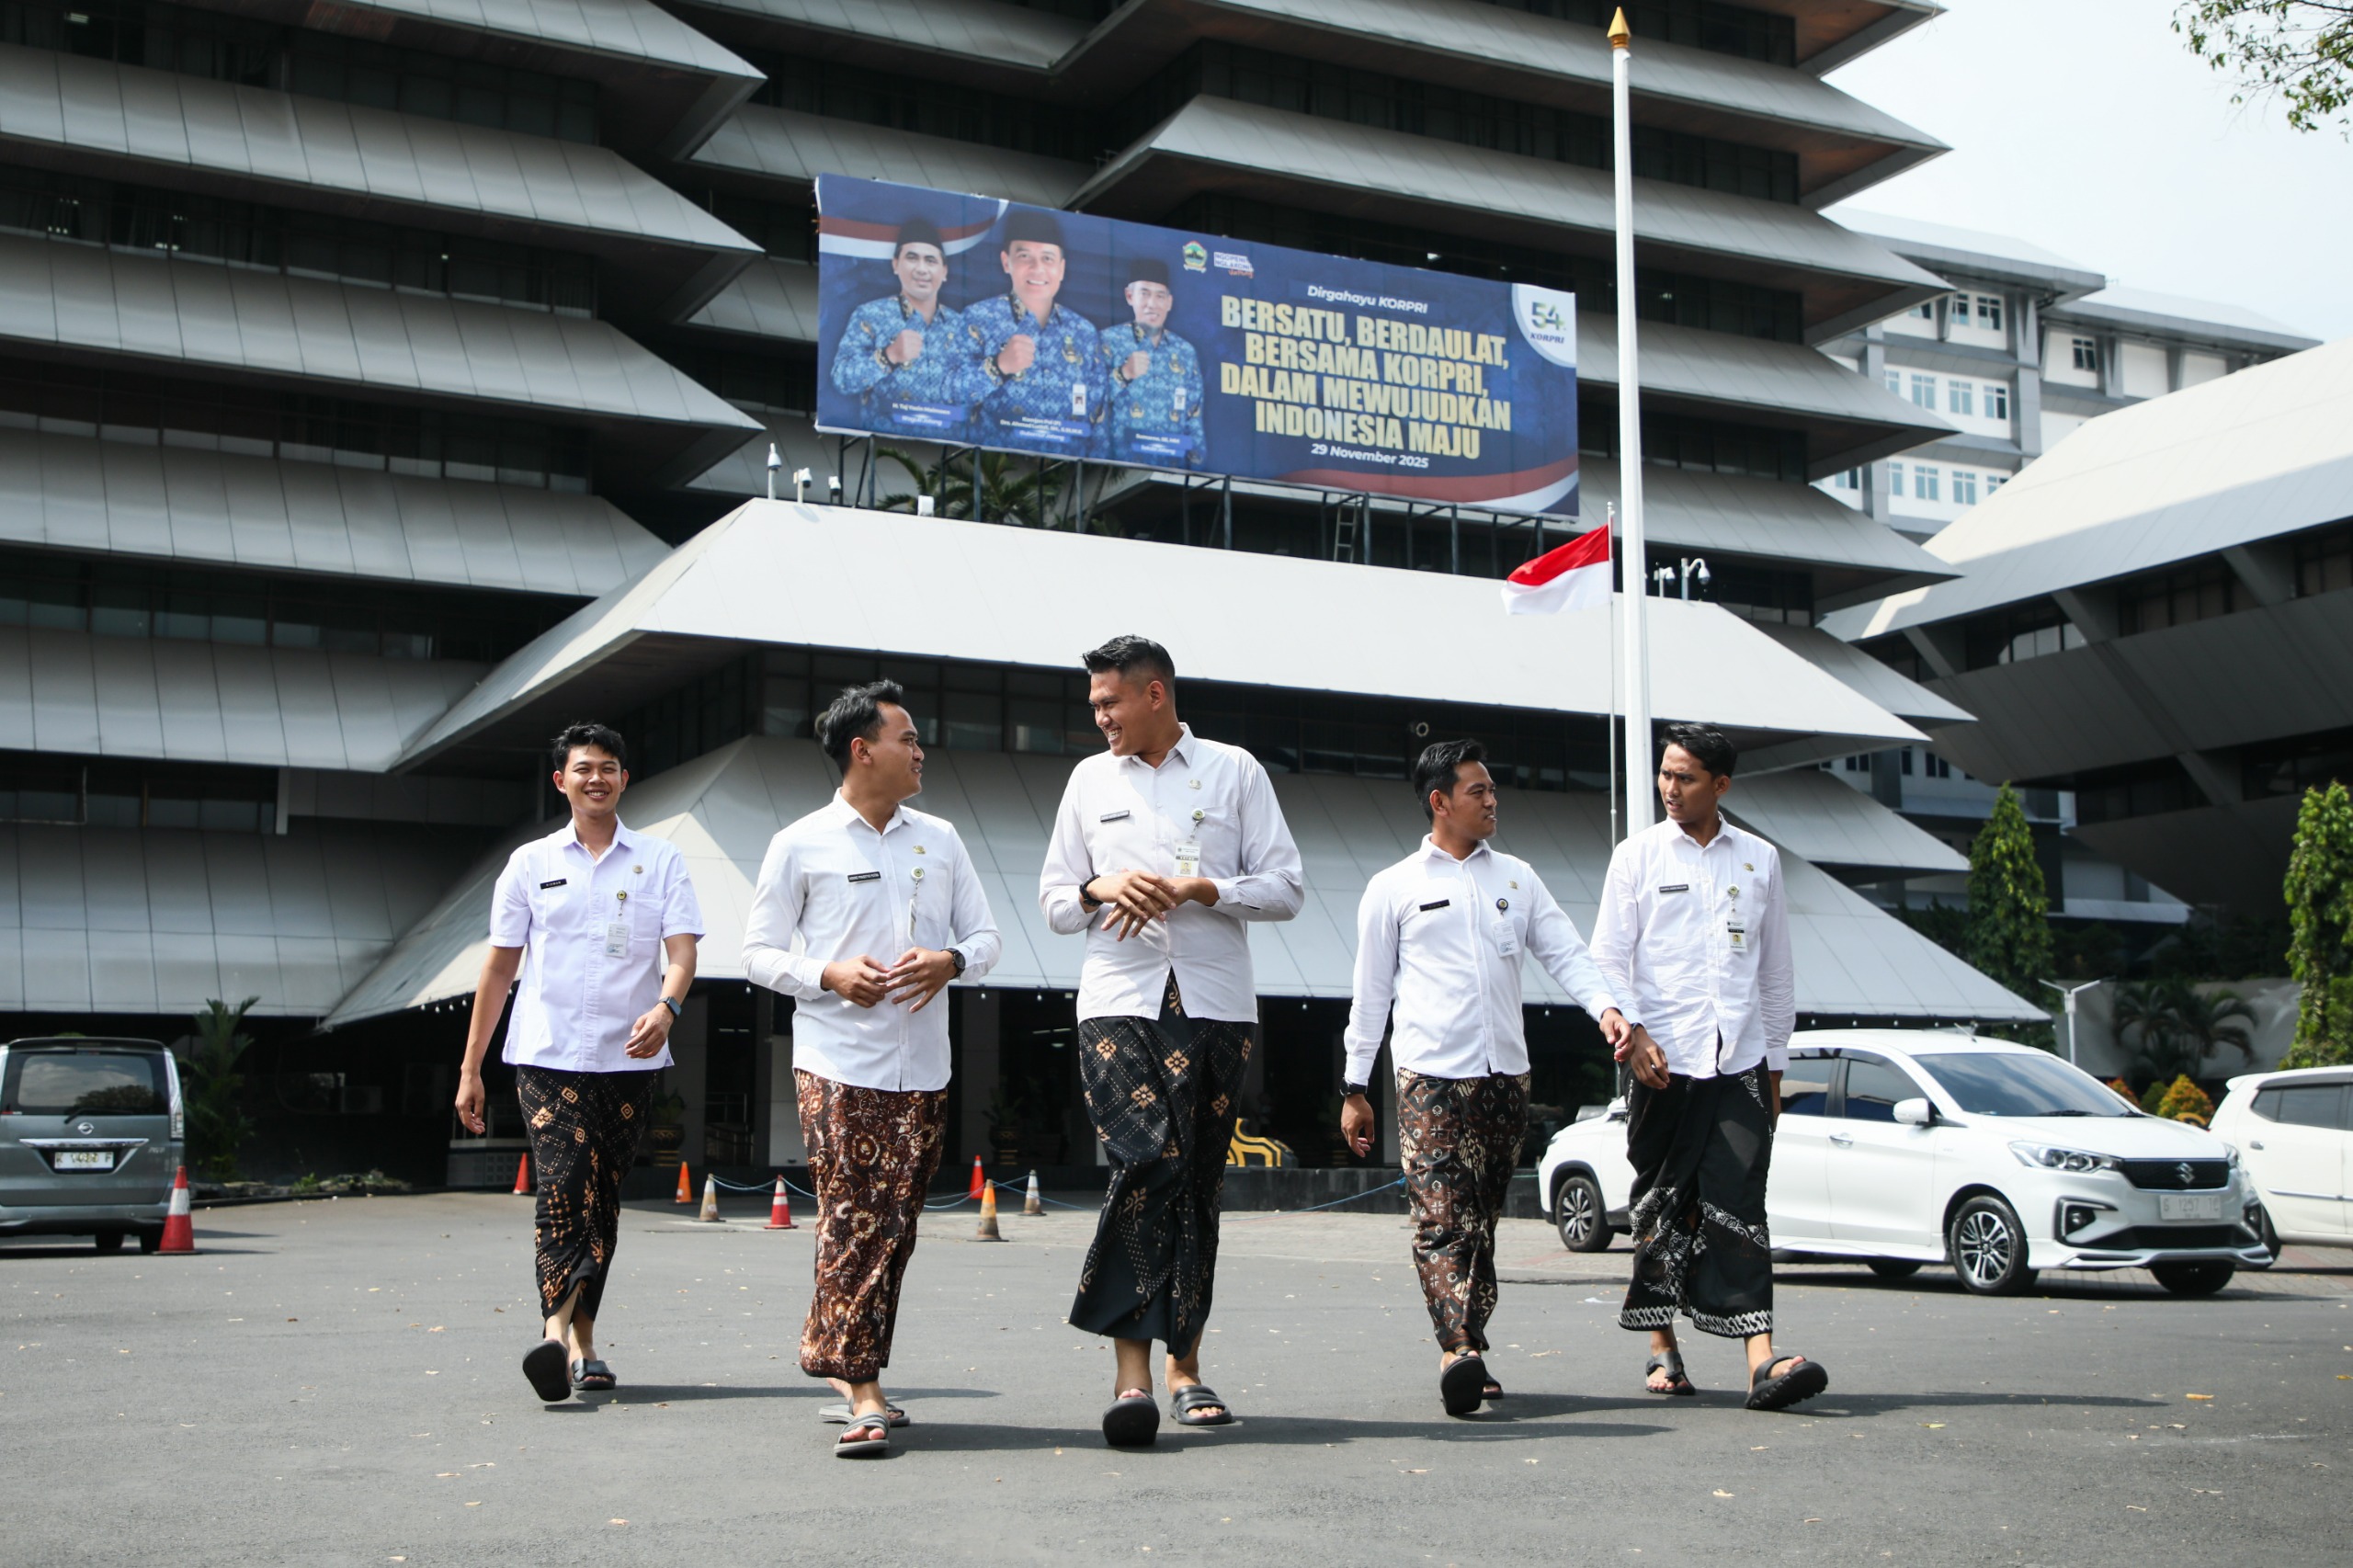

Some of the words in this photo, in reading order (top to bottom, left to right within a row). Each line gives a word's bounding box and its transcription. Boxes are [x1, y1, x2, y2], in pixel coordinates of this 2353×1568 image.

[1307, 285, 1376, 307] Dirgahayu
[1378, 295, 1429, 314] KORPRI
[1531, 301, 1564, 331] 54
[1221, 294, 1352, 348] BERSATU,
[1356, 314, 1509, 370] BERDAULAT,
[1529, 332, 1565, 345] KORPRI
[1245, 331, 1380, 381] BERSAMA
[1383, 355, 1489, 399] KORPRI,
[1221, 361, 1317, 405] DALAM
[1323, 375, 1511, 432] MEWUJUDKAN
[1256, 400, 1404, 449] INDONESIA
[1408, 424, 1481, 460] MAJU
[1311, 442, 1328, 456] 29
[1330, 445, 1397, 466] November
[1399, 454, 1430, 469] 2025
